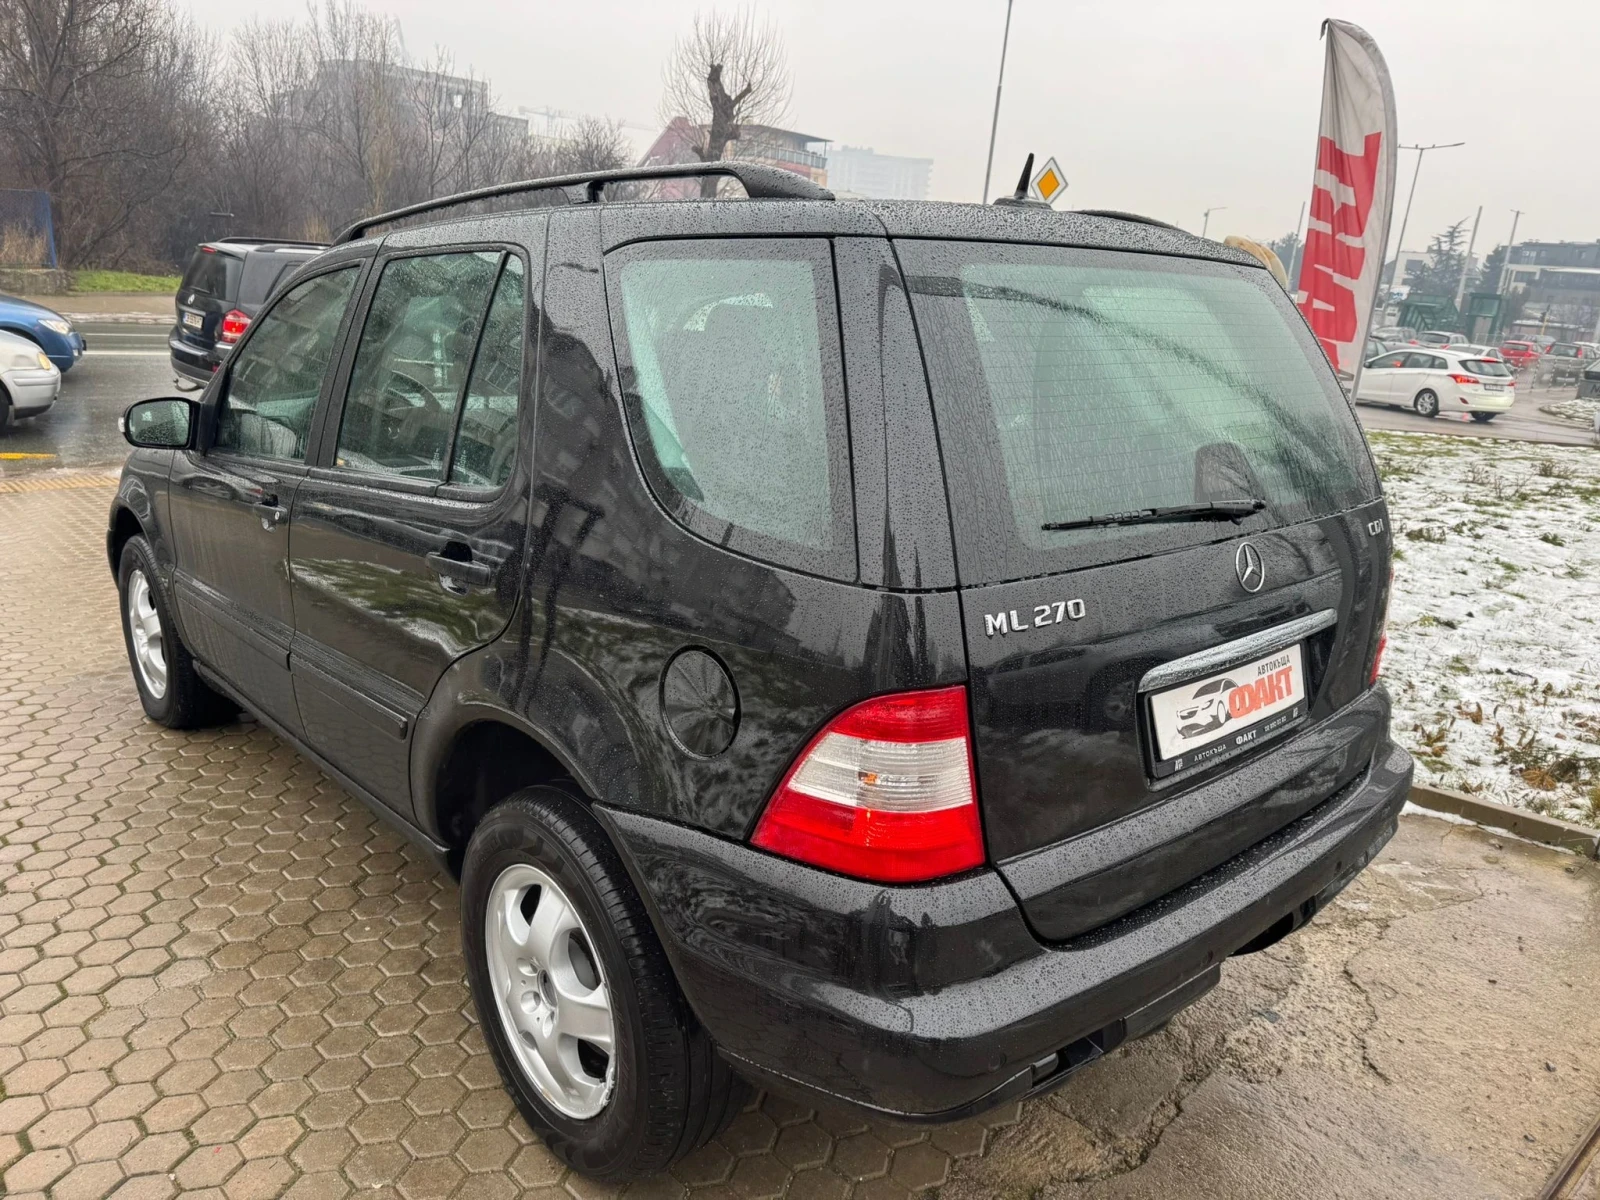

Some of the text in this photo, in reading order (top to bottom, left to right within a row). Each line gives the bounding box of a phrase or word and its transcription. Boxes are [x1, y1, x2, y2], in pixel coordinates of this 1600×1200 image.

[1367, 519, 1384, 536] CDI
[984, 599, 1086, 636] ML 270
[1229, 665, 1292, 718] ФАКТ
[1235, 730, 1257, 745] ФАКТ
